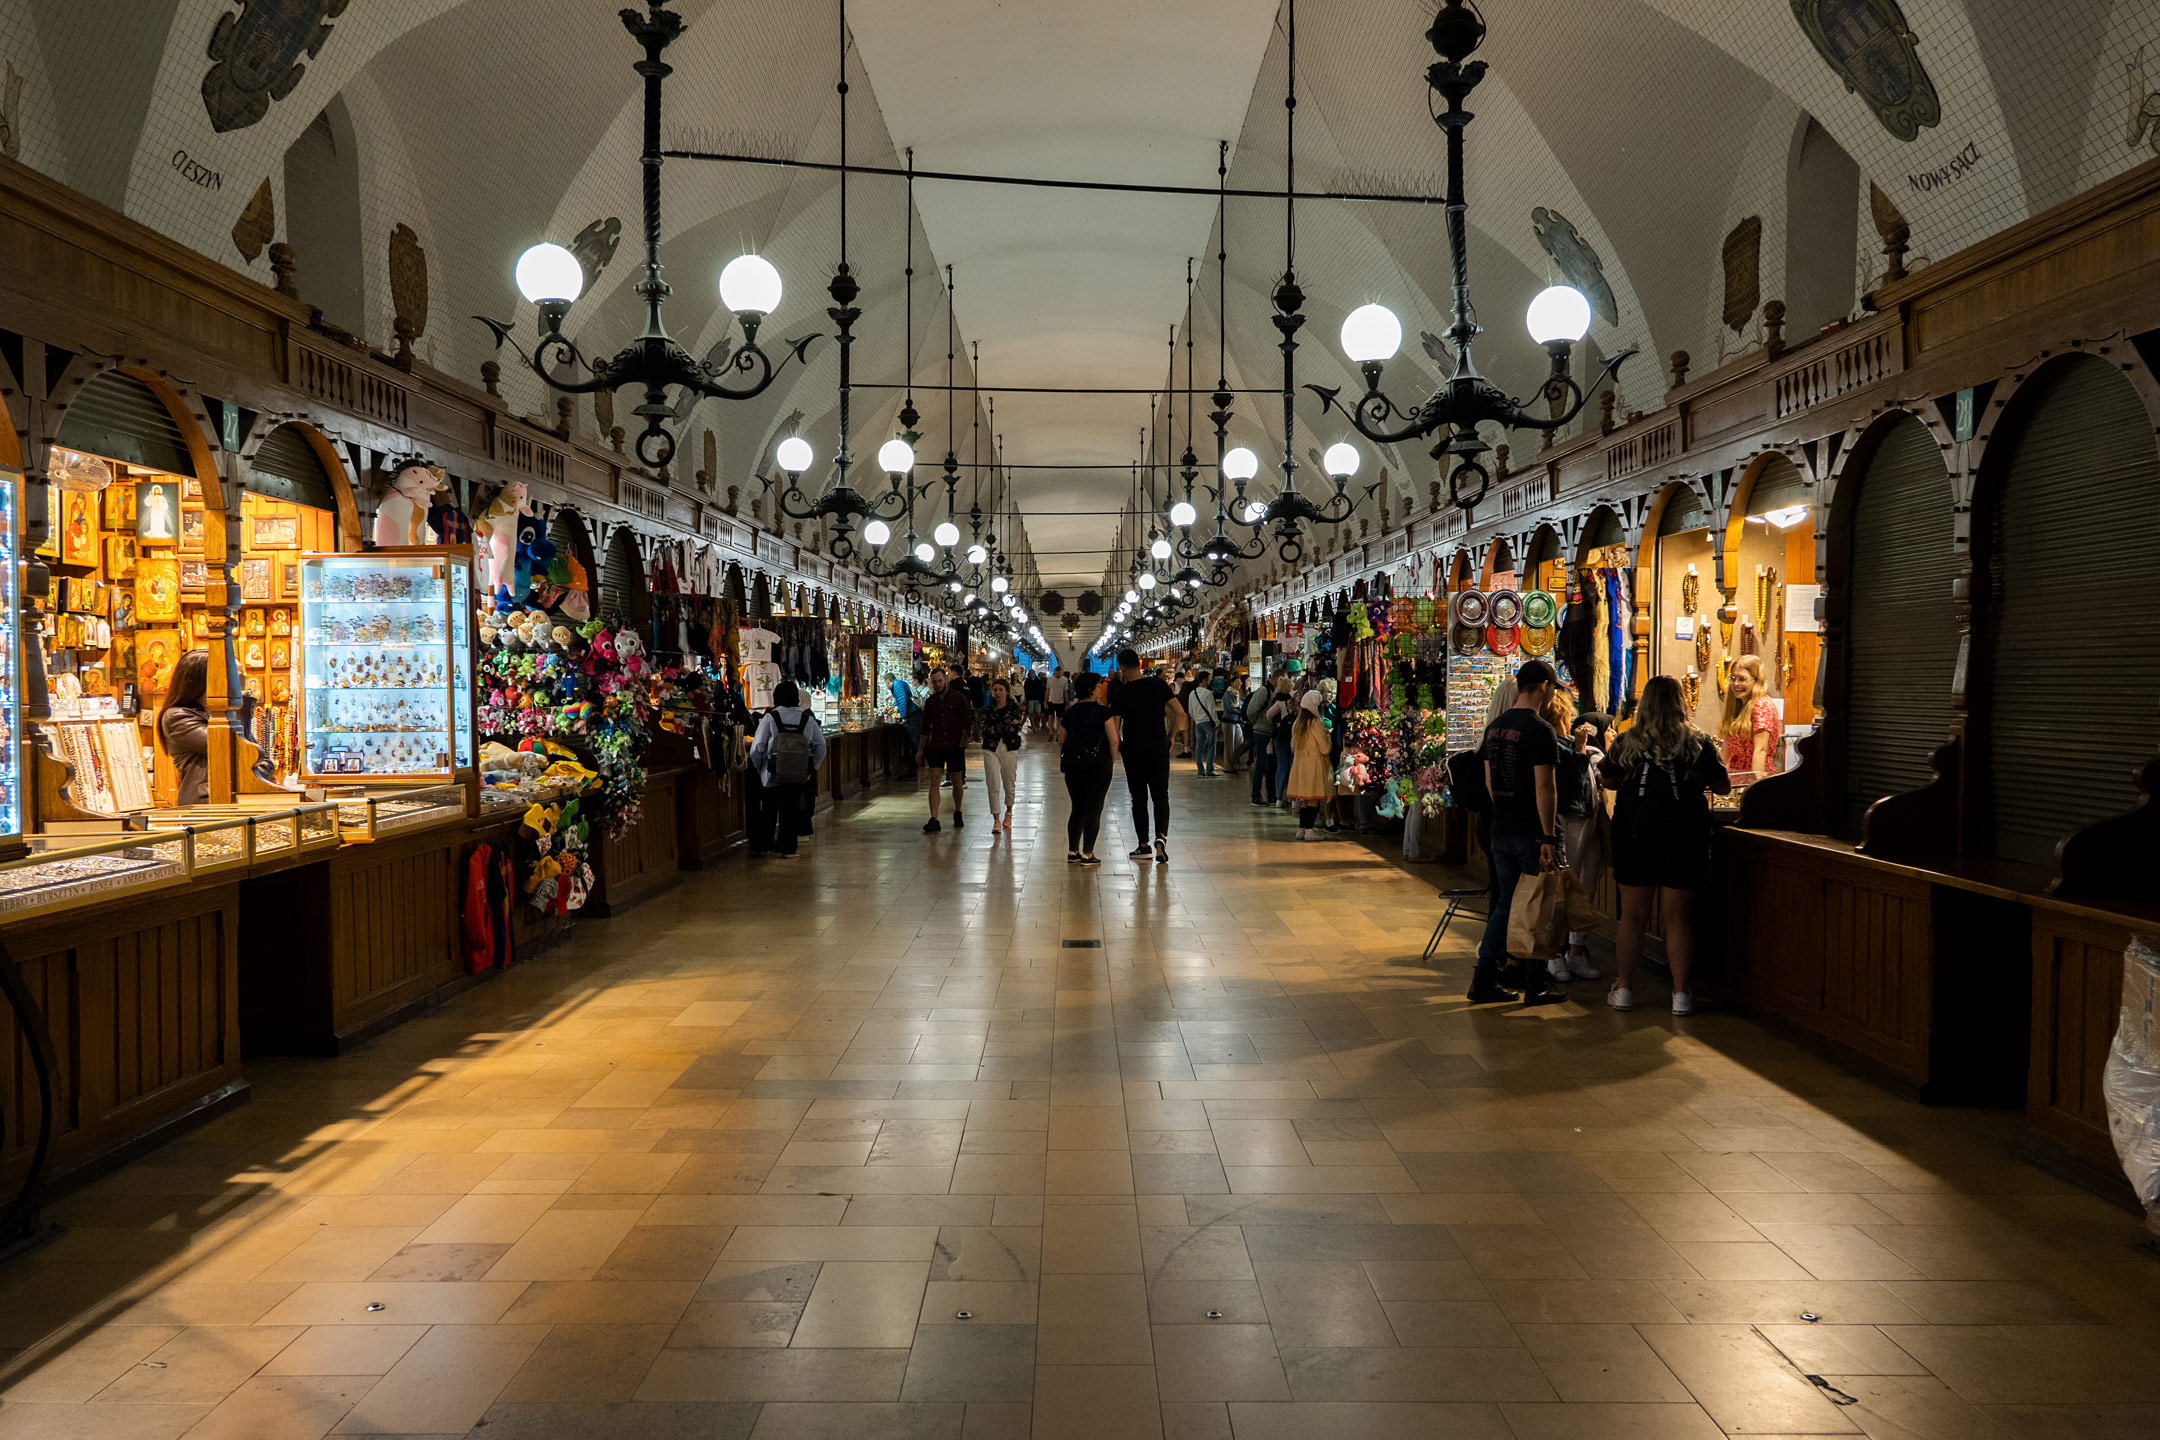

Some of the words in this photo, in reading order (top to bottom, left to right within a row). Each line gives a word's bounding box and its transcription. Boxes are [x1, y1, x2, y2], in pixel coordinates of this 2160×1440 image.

[171, 149, 225, 192] CIESZYN
[1907, 165, 1951, 192] NOWY
[1949, 141, 1982, 180] SĄCZ
[223, 410, 238, 445] 27
[1956, 397, 1972, 432] 28
[37, 886, 80, 902] BURSZTYN
[122, 873, 147, 885] AMBER
[153, 867, 177, 878] SILVER
